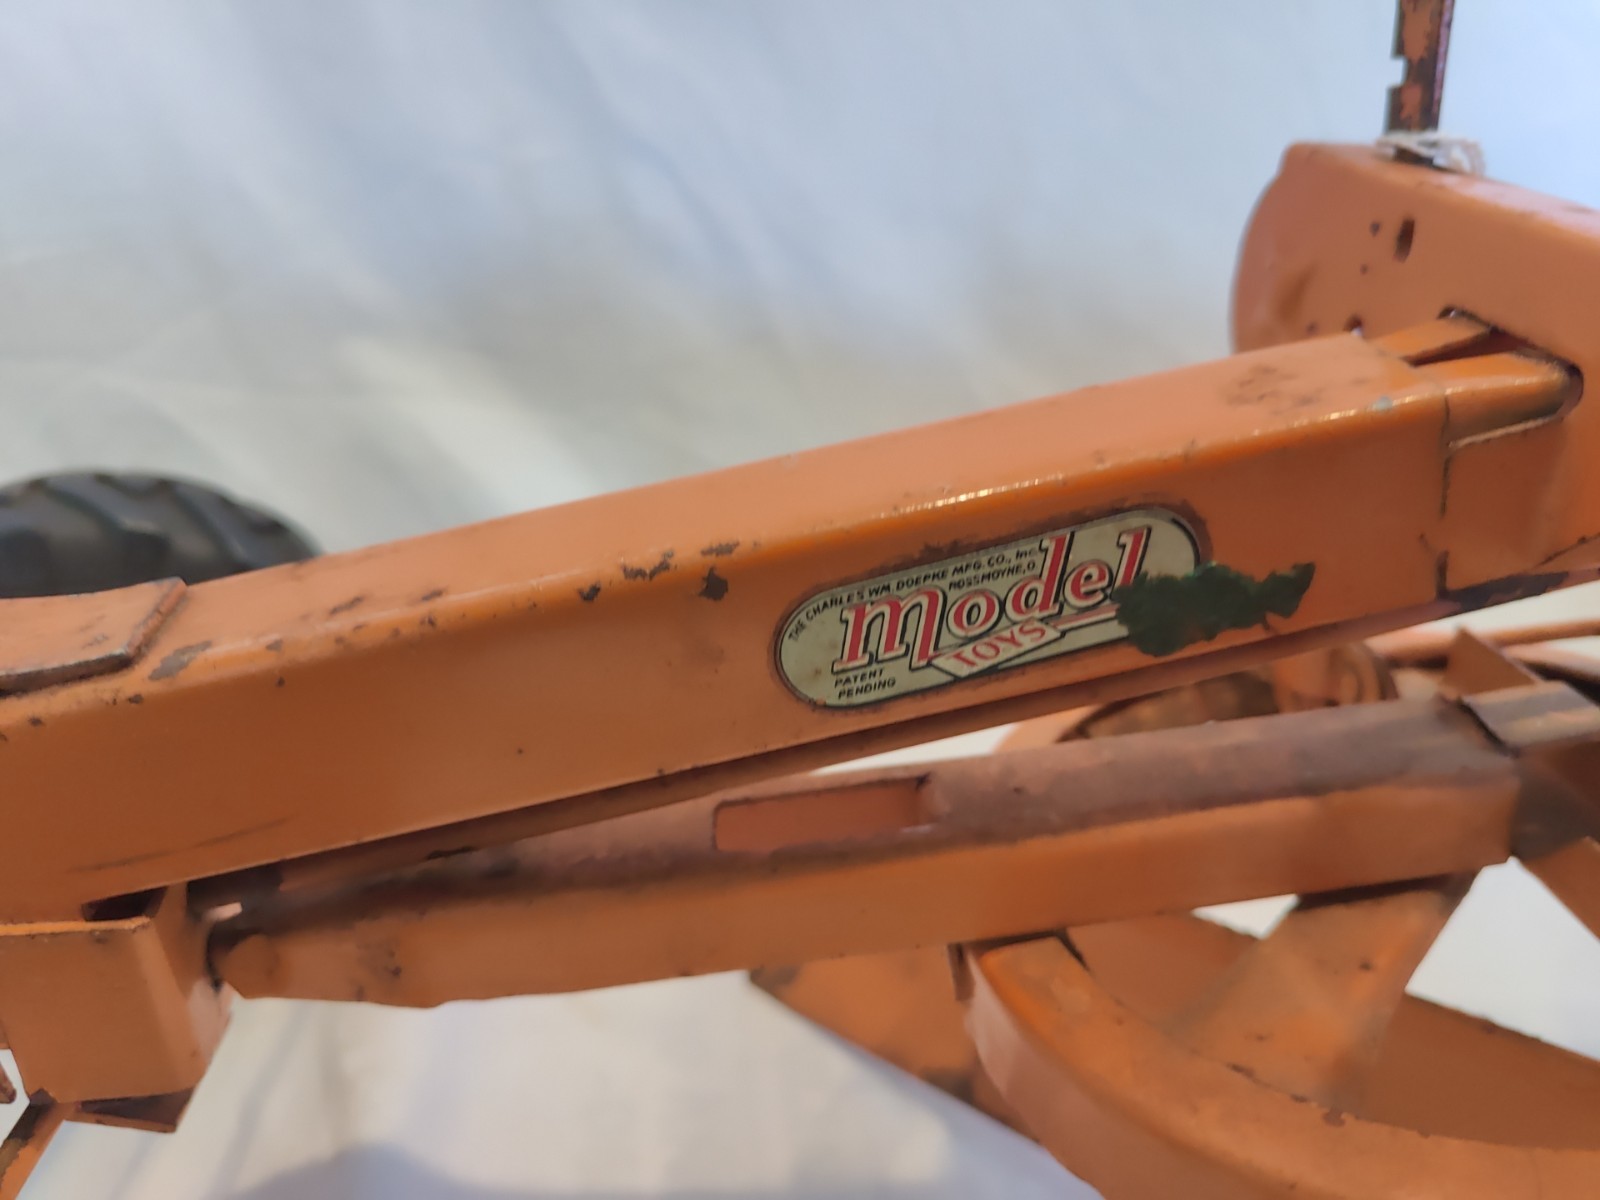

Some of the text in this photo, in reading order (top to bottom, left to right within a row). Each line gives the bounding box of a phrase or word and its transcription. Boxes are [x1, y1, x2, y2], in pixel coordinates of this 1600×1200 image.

[788, 618, 807, 642] THE
[806, 590, 865, 620] CHARLES
[896, 568, 949, 591] DOEPKE
[951, 617, 1048, 668] TOYS
[834, 668, 884, 688] PATENT
[838, 677, 897, 699] PENDING
